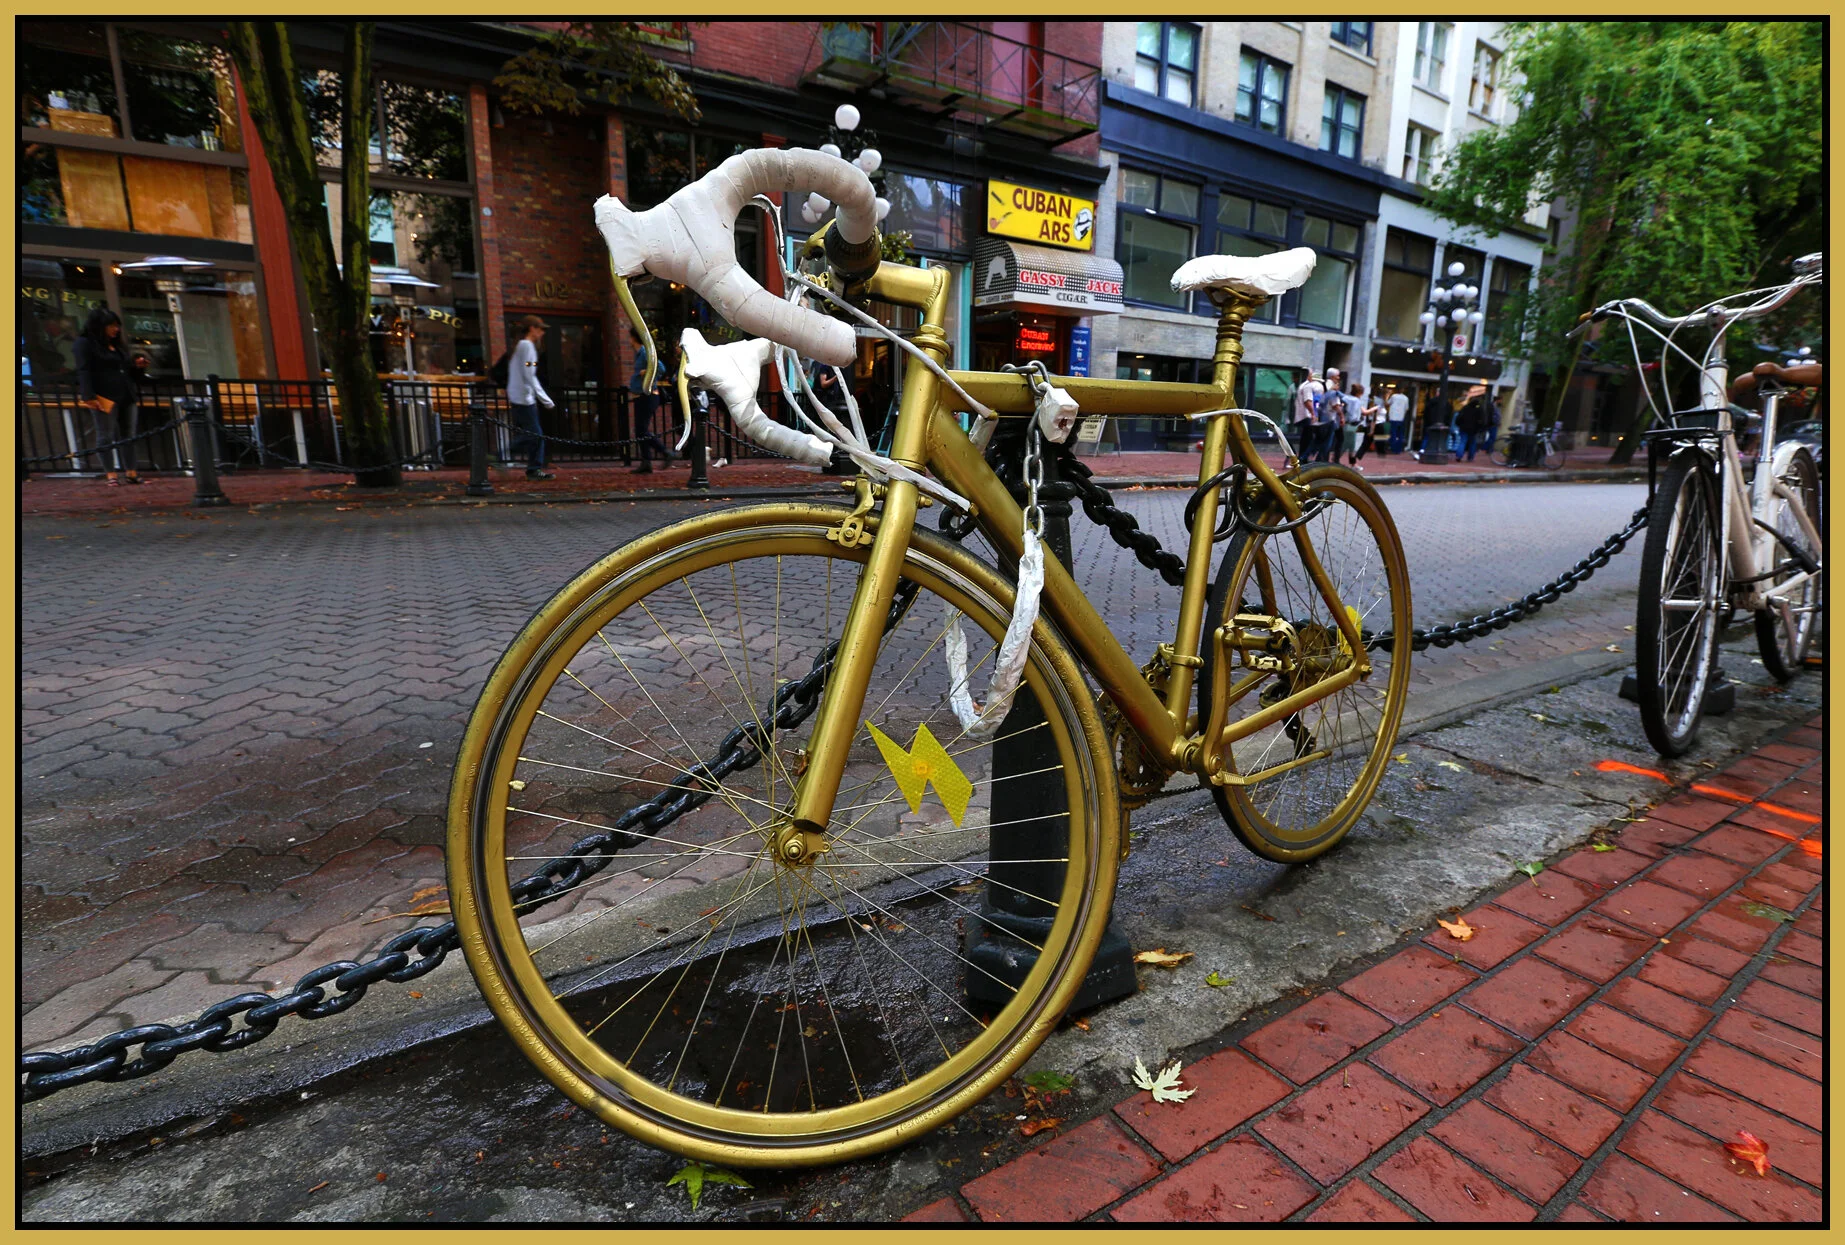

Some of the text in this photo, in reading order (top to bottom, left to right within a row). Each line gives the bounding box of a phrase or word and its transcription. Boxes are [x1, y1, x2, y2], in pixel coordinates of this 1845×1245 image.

[1012, 188, 1072, 219] CUBAN
[1038, 219, 1071, 244] ARS
[1019, 269, 1122, 296] GASSY JACK
